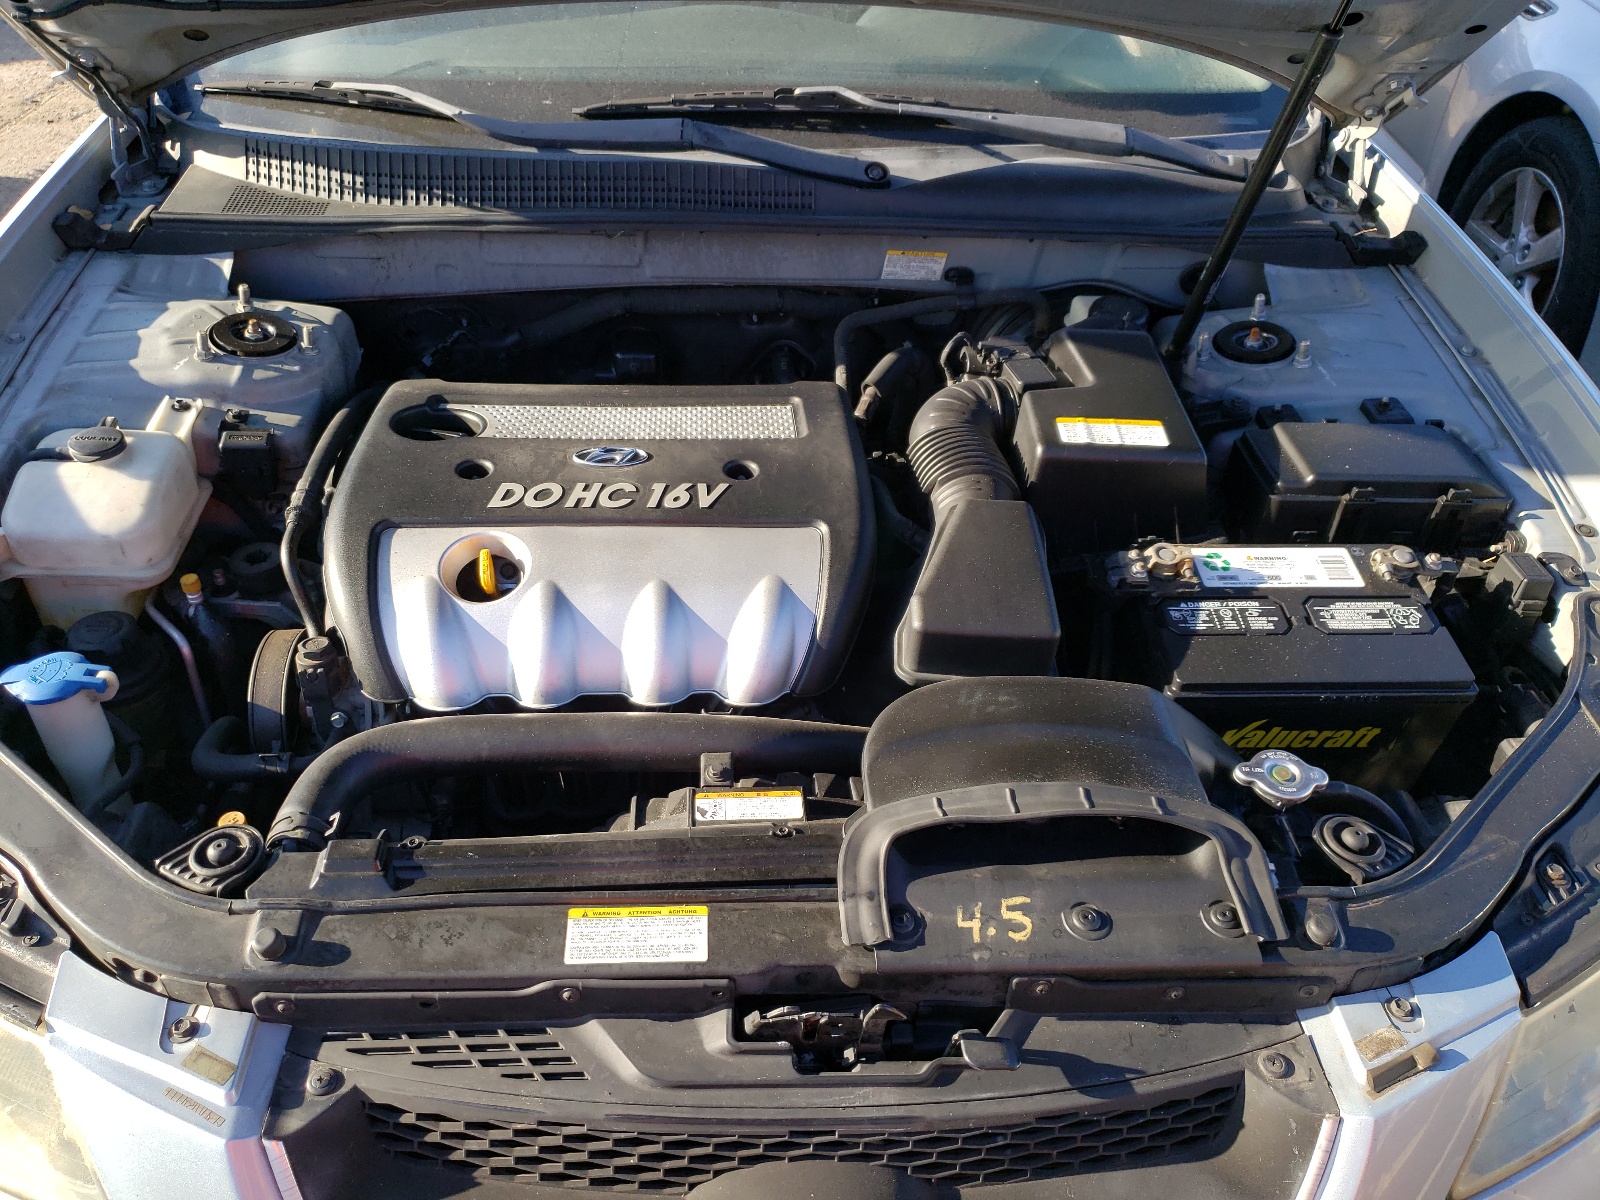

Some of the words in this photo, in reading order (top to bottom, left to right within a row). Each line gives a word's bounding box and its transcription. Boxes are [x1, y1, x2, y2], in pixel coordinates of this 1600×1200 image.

[646, 482, 731, 510] 16V
[1222, 718, 1383, 748] Valucraft
[957, 896, 1033, 942] 4.5
